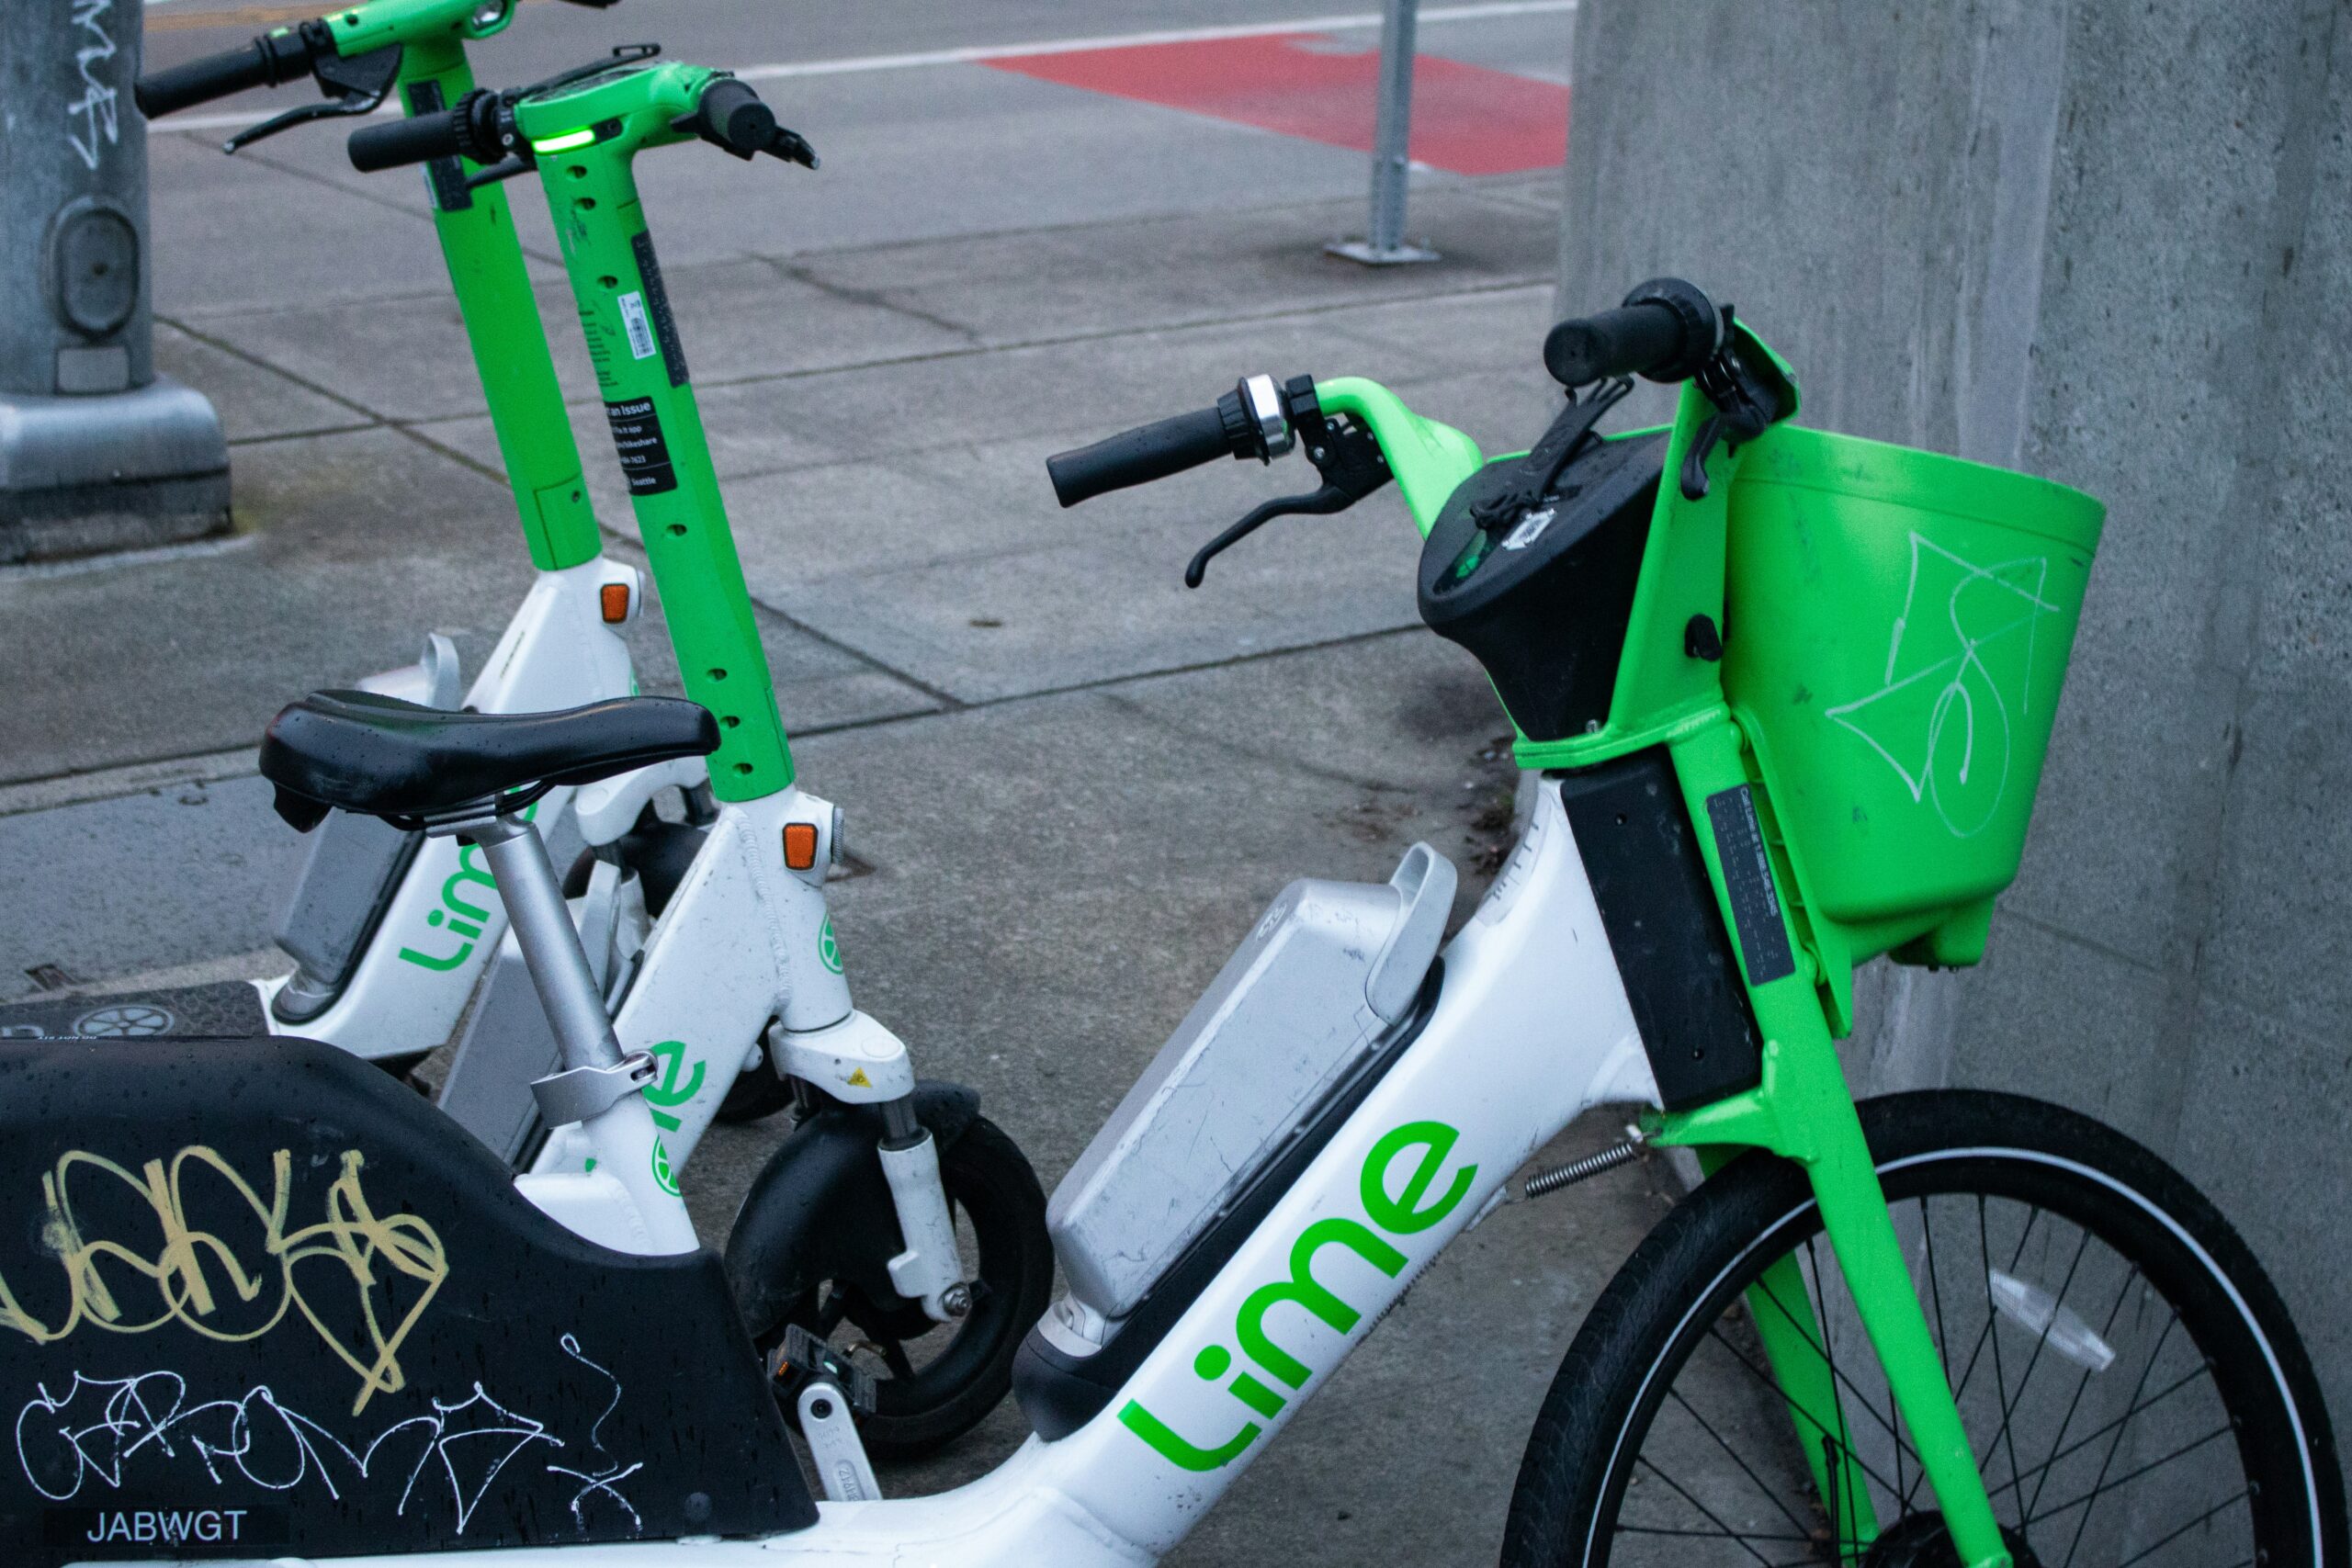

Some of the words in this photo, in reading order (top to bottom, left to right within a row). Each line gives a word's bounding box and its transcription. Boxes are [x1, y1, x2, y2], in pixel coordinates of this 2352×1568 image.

[622, 402, 651, 415] Issue
[631, 477, 656, 486] Seattle
[1117, 1121, 1478, 1472] Lime
[87, 1510, 247, 1541] JABWGT
